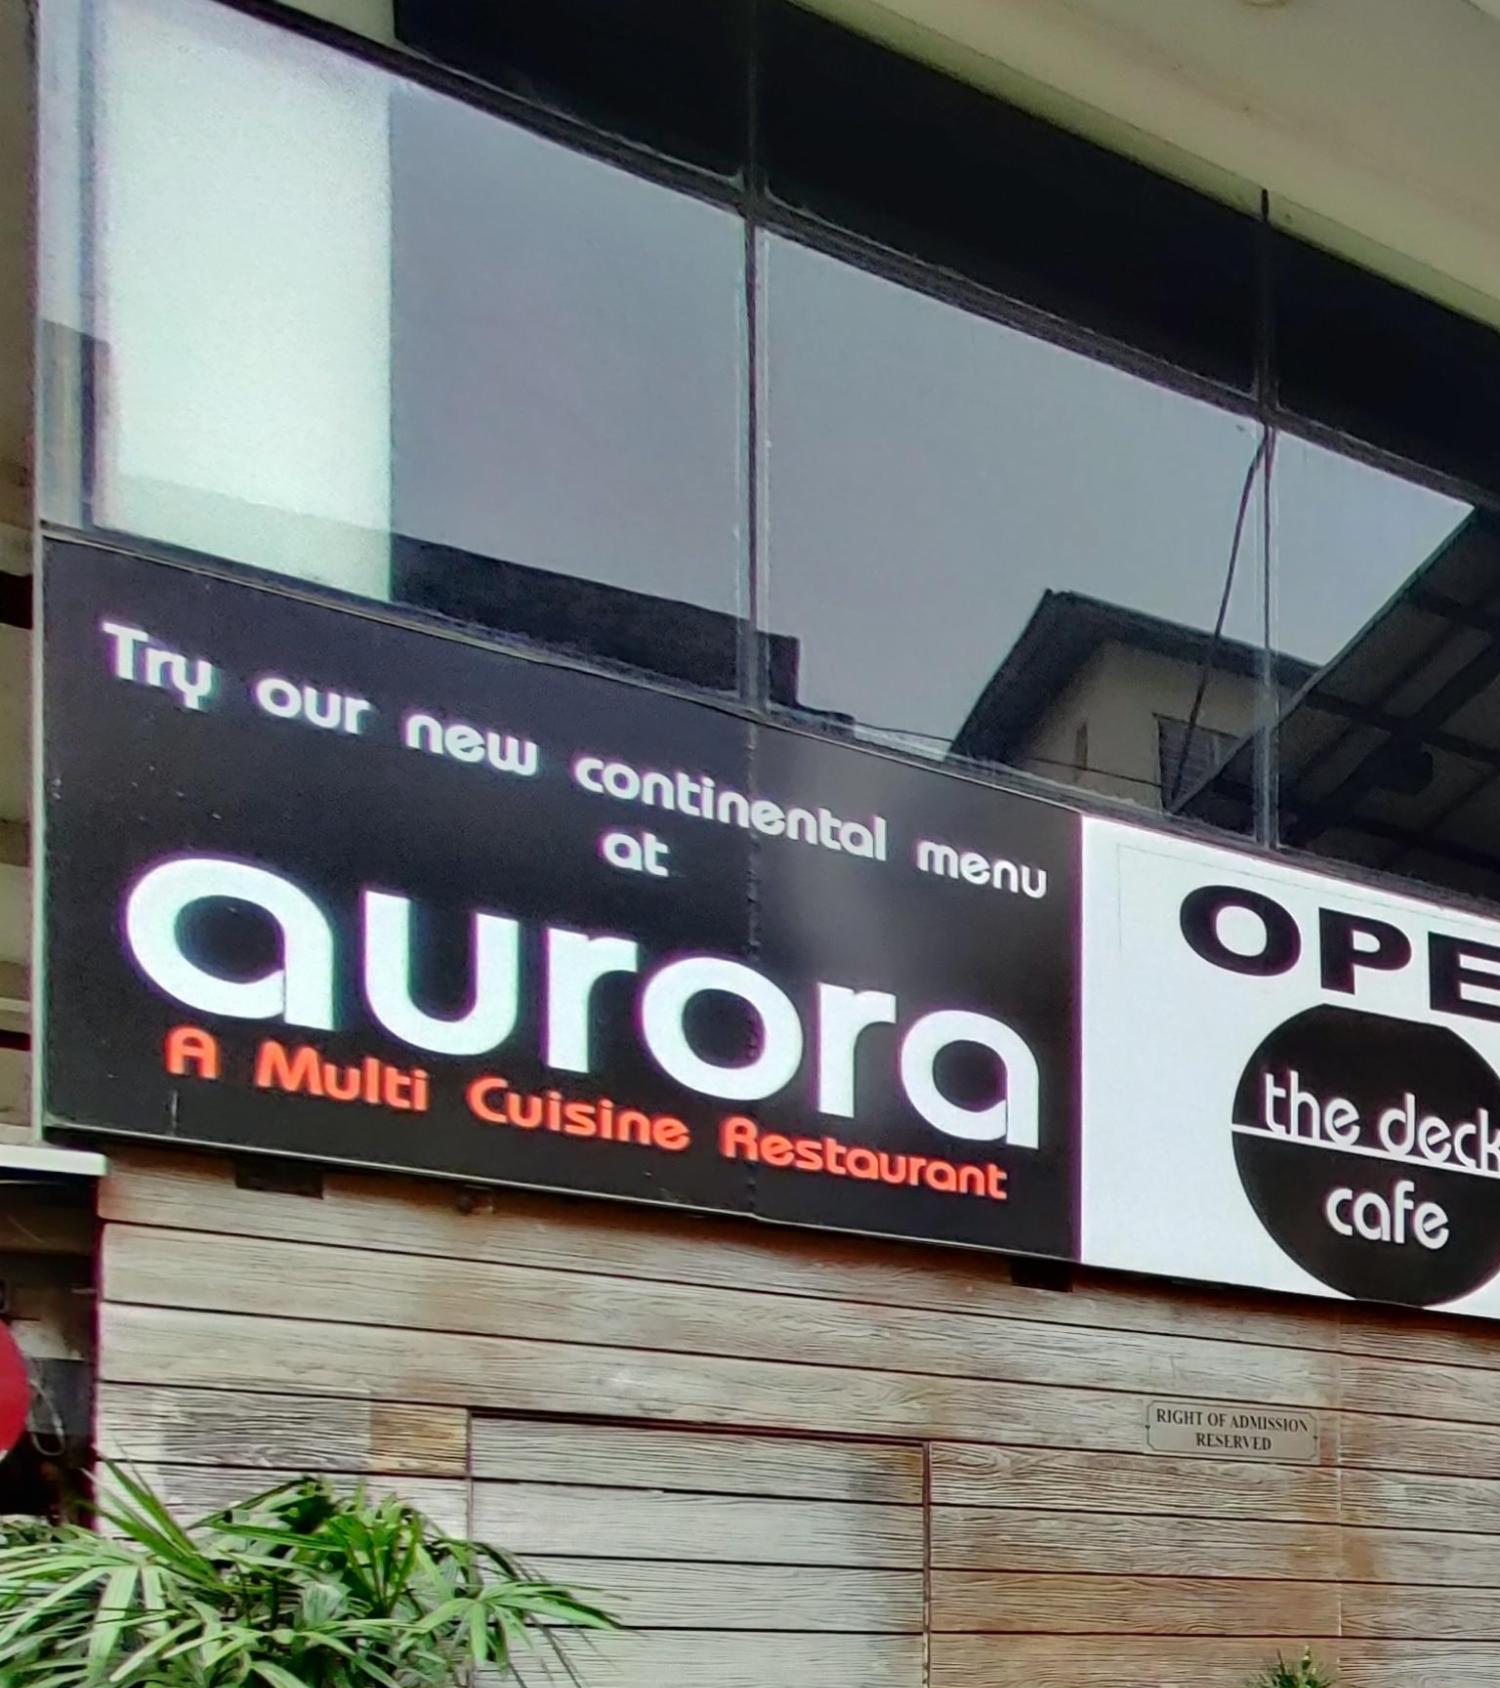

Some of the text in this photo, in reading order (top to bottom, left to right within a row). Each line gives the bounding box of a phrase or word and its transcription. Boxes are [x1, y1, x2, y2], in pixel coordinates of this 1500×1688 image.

[100, 620, 1047, 898] Try our new continental menu
[604, 829, 668, 878] at
[126, 857, 1040, 1150] aurora
[165, 1026, 1007, 1199] A Multi Cuisine Restaurant
[1264, 1070, 1360, 1146] the
[1325, 1181, 1449, 1251] cafe
[1156, 1408, 1308, 1432] RIGHT OF ADMISSION
[1195, 1432, 1272, 1451] RESERVED
